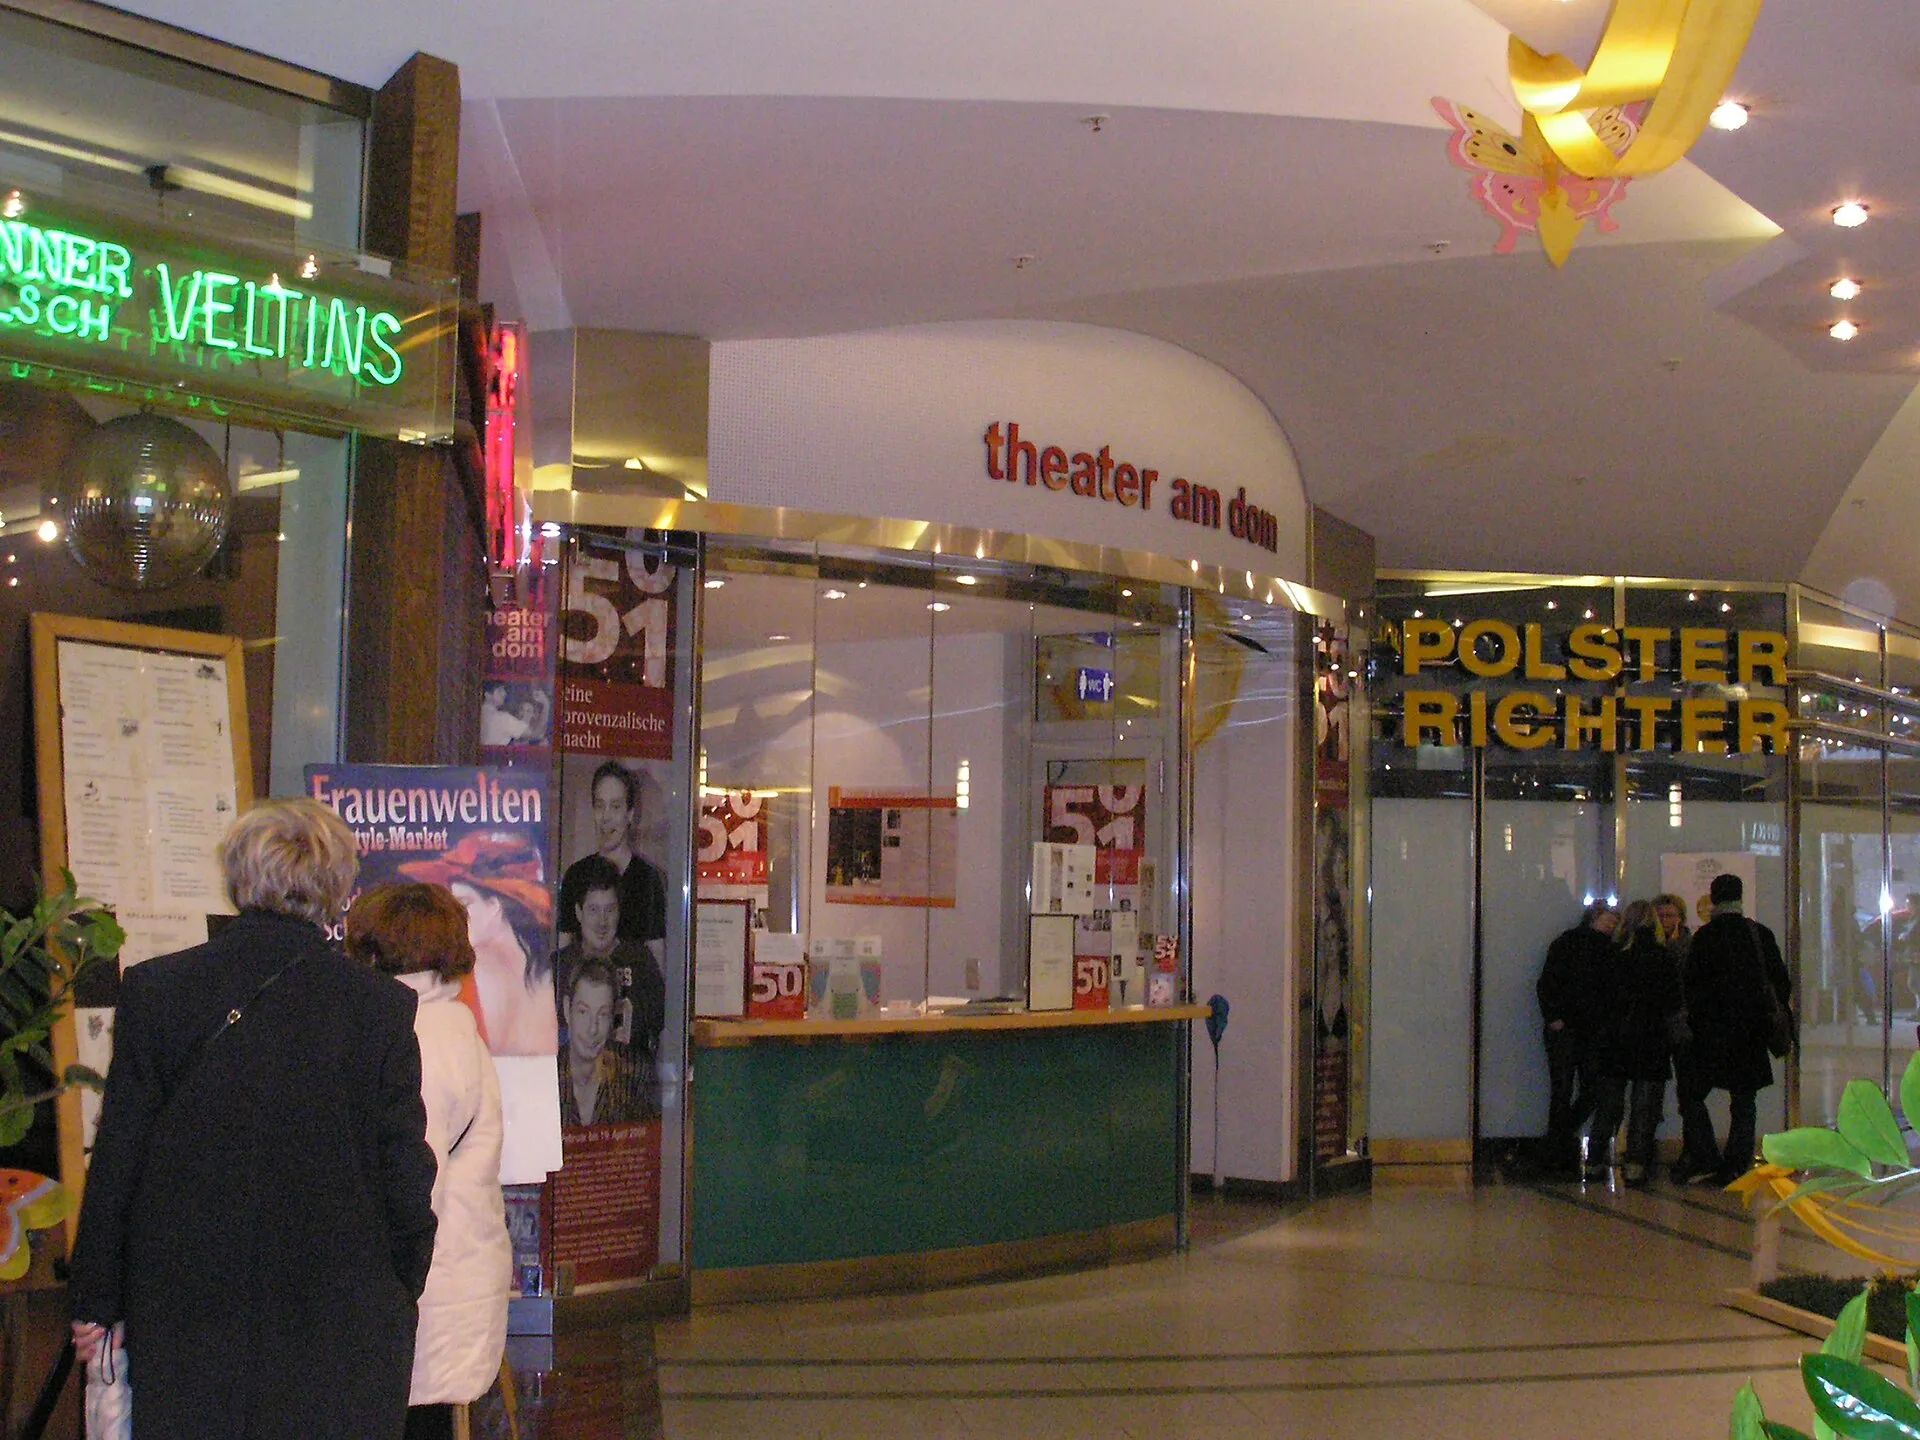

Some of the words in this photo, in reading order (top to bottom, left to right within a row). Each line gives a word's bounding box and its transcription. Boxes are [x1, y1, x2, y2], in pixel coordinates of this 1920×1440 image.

[156, 263, 402, 385] VELTINS
[985, 421, 1158, 510] theater
[1171, 478, 1221, 529] am
[1229, 486, 1278, 554] dom
[483, 608, 552, 628] eater
[507, 627, 544, 642] am
[492, 638, 544, 659] dom
[1402, 619, 1789, 687] POLSTER
[1403, 691, 1789, 756] RICHTER
[312, 771, 542, 825] Frauenwelten
[352, 826, 448, 858] tyle-Market
[753, 965, 803, 1004] 50
[1075, 959, 1108, 995] 50
